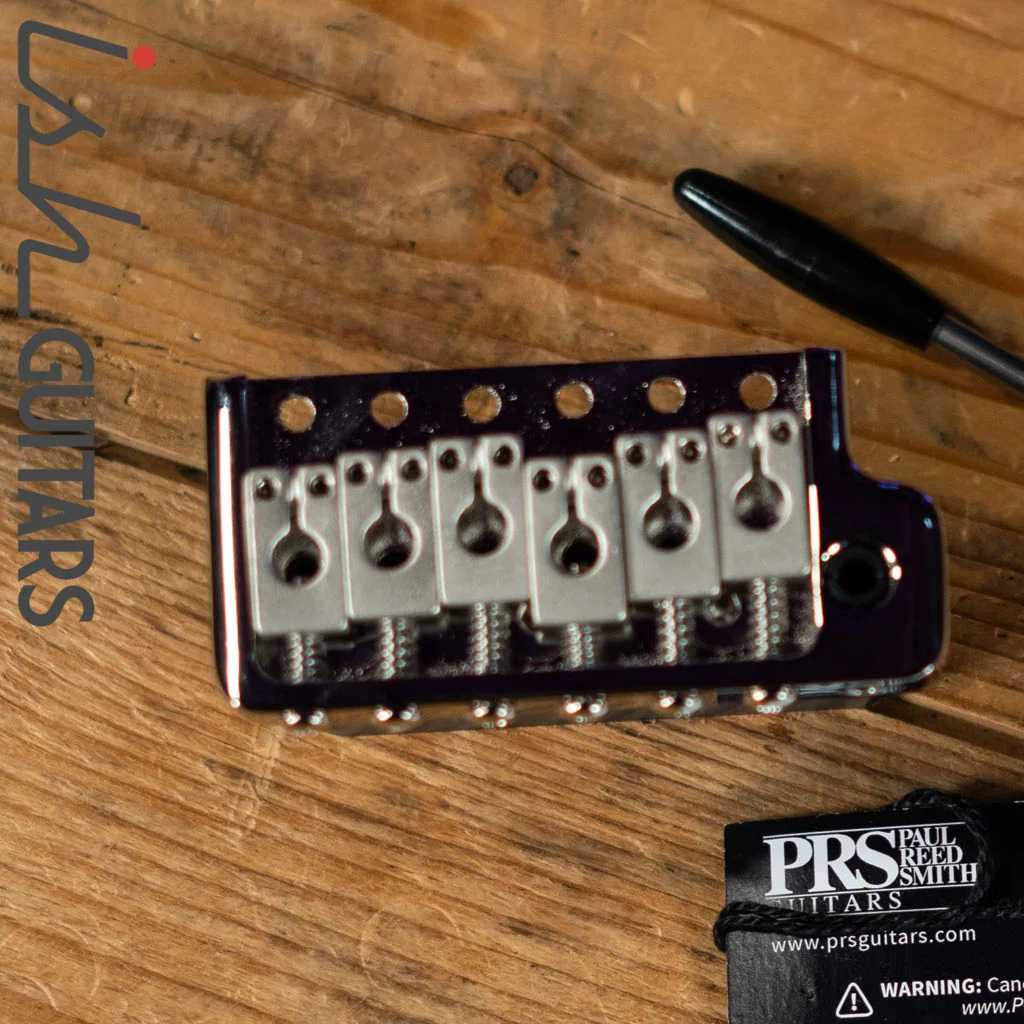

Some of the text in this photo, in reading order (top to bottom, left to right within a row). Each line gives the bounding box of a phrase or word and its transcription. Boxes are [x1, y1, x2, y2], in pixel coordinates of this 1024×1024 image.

[898, 826, 956, 849] PAUL
[762, 829, 899, 897] PRS
[899, 845, 964, 867] REED
[899, 862, 978, 886] SMITH
[772, 928, 976, 952] www.prsguitars.com
[880, 979, 981, 999] WARNING:
